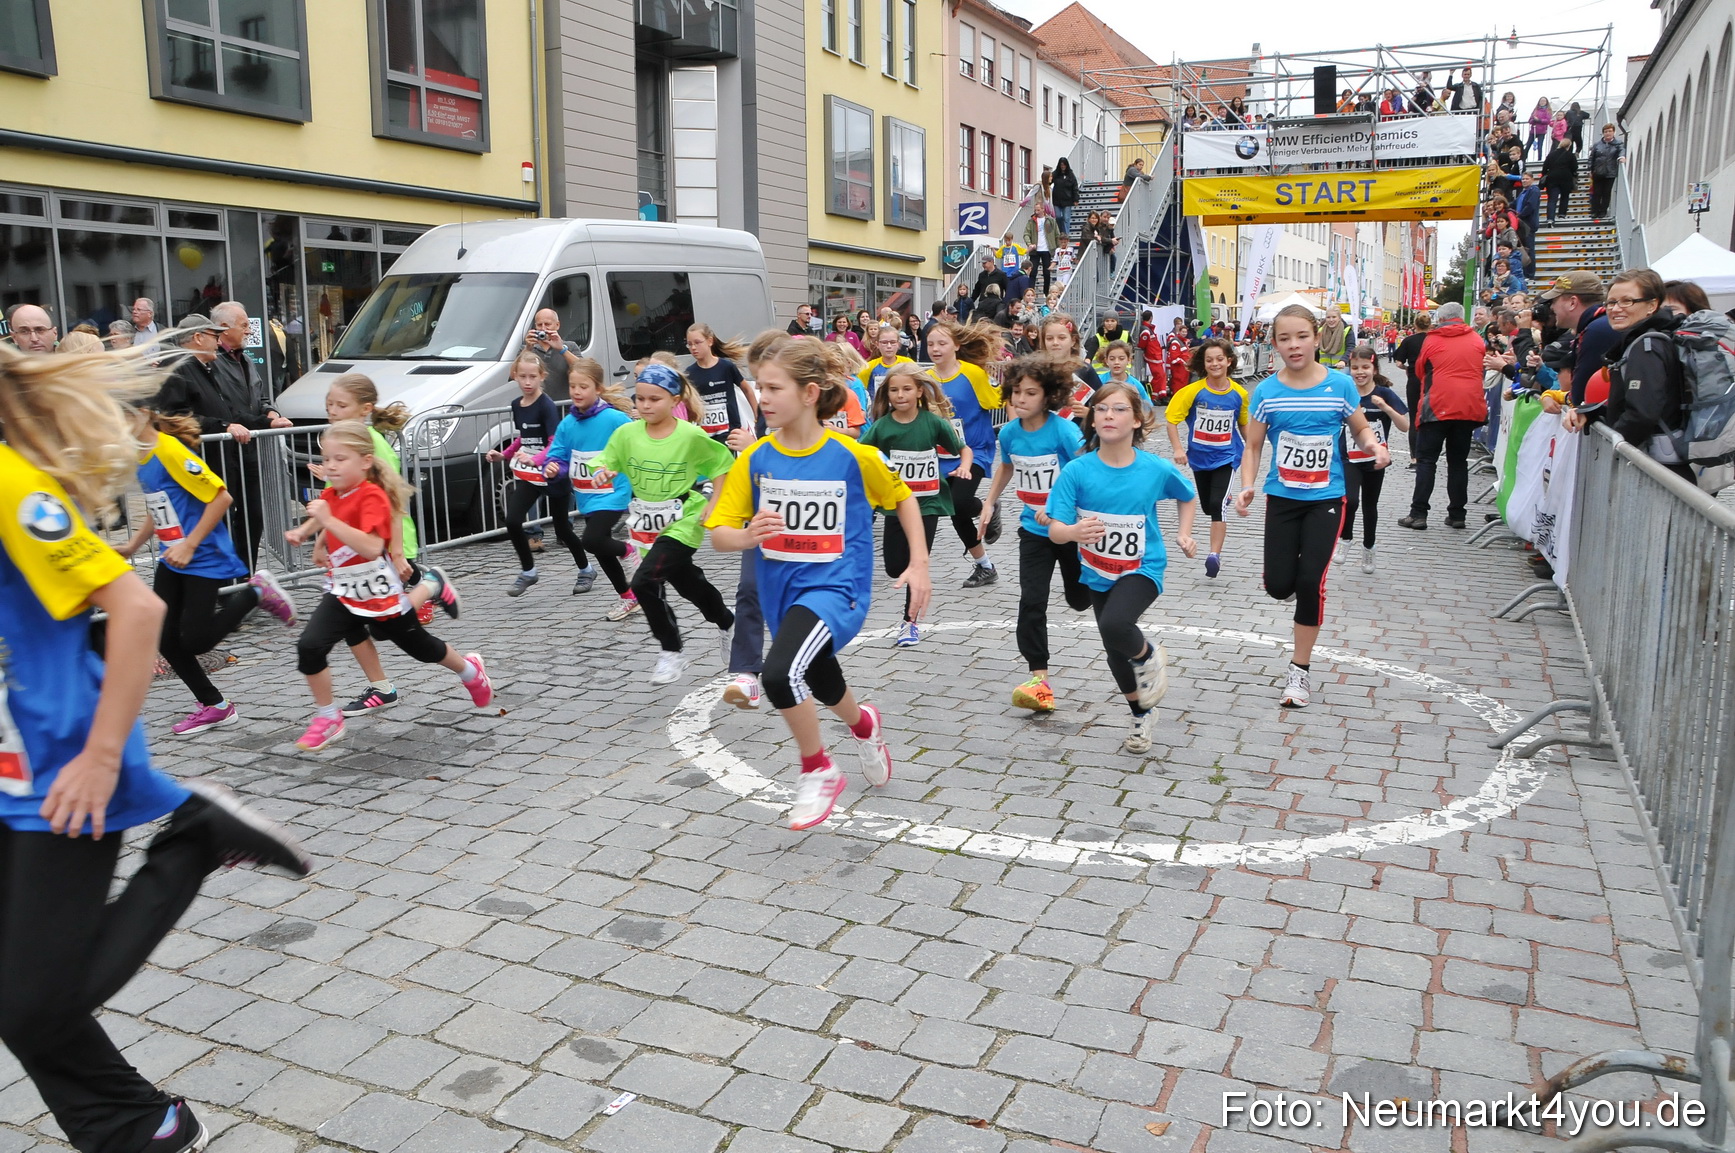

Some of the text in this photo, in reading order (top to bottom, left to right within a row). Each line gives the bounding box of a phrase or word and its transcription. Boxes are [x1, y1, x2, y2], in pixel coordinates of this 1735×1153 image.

[1266, 129, 1418, 147] BMW EfficientDynamics
[1266, 147, 1299, 157] Weniger
[1300, 145, 1345, 155] Verbrauch.
[1347, 144, 1368, 153] Mehr
[1275, 180, 1377, 205] START
[1250, 255, 1267, 300] Audi BKK
[1200, 417, 1230, 432] 7049
[1283, 445, 1328, 469] 7599
[894, 461, 935, 479] 7076
[1015, 468, 1055, 490] 7117
[762, 486, 833, 497] PARTL Neumarkt
[768, 500, 837, 530] 7020
[783, 538, 818, 551] Maria
[1086, 531, 1139, 556] 028
[340, 574, 390, 600] 7113
